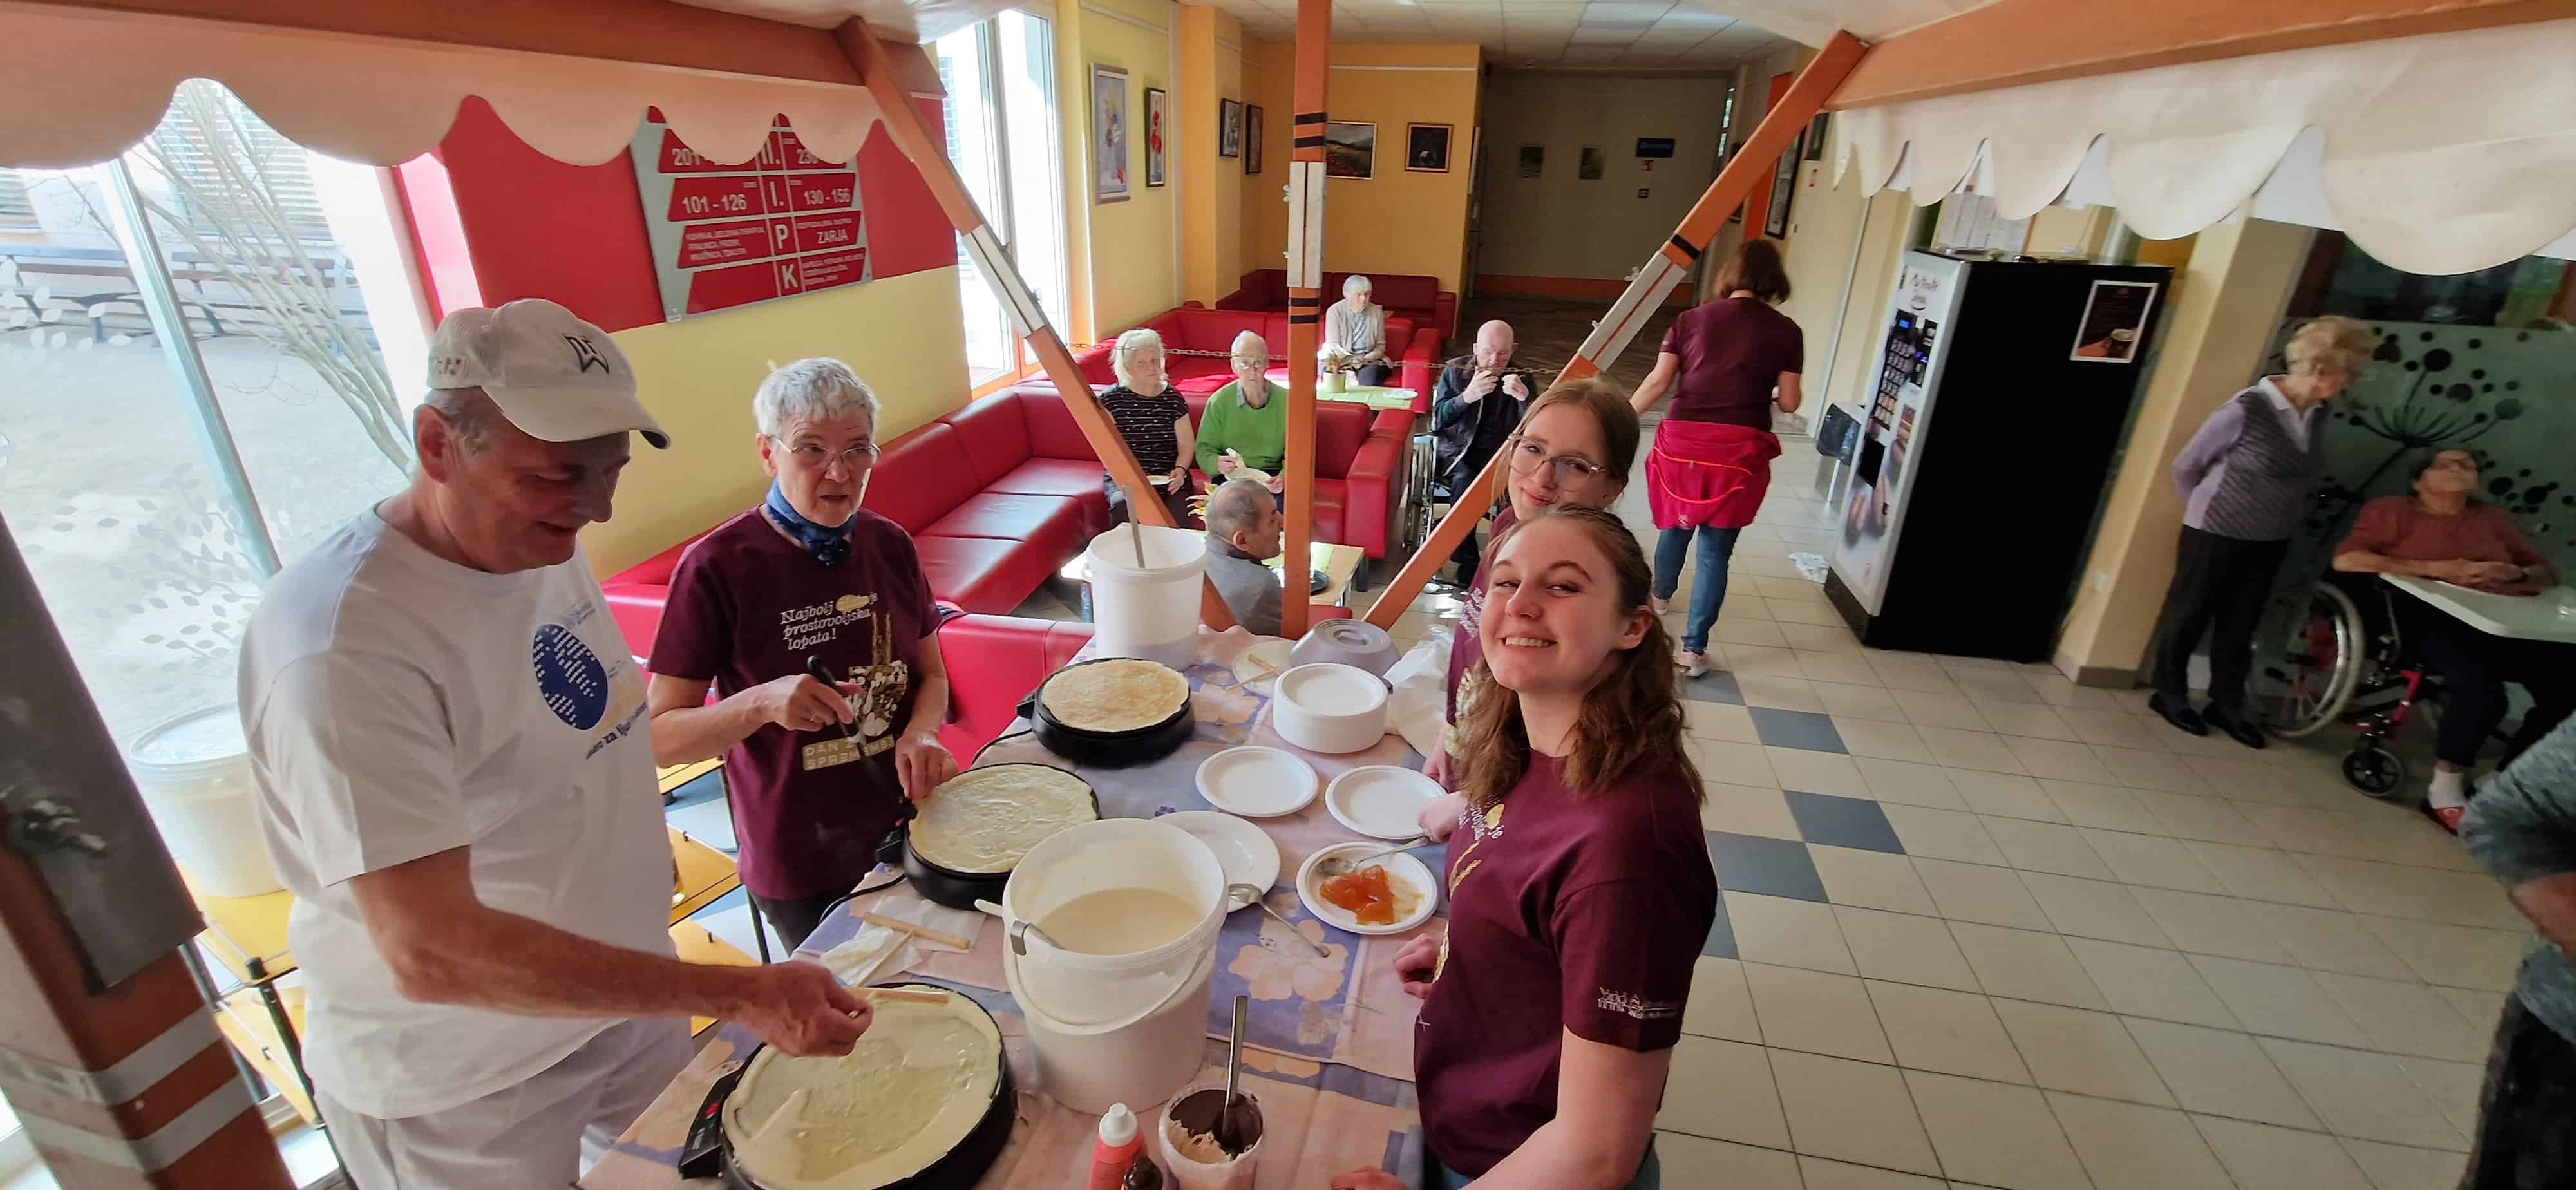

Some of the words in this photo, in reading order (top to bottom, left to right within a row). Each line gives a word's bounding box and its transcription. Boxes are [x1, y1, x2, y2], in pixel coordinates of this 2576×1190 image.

[682, 196, 709, 214] 101
[721, 194, 747, 211] 126
[804, 189, 825, 205] 130
[775, 223, 790, 249] P
[816, 229, 849, 244] ZARJA
[782, 264, 798, 290] K
[779, 601, 835, 625] Najbolj
